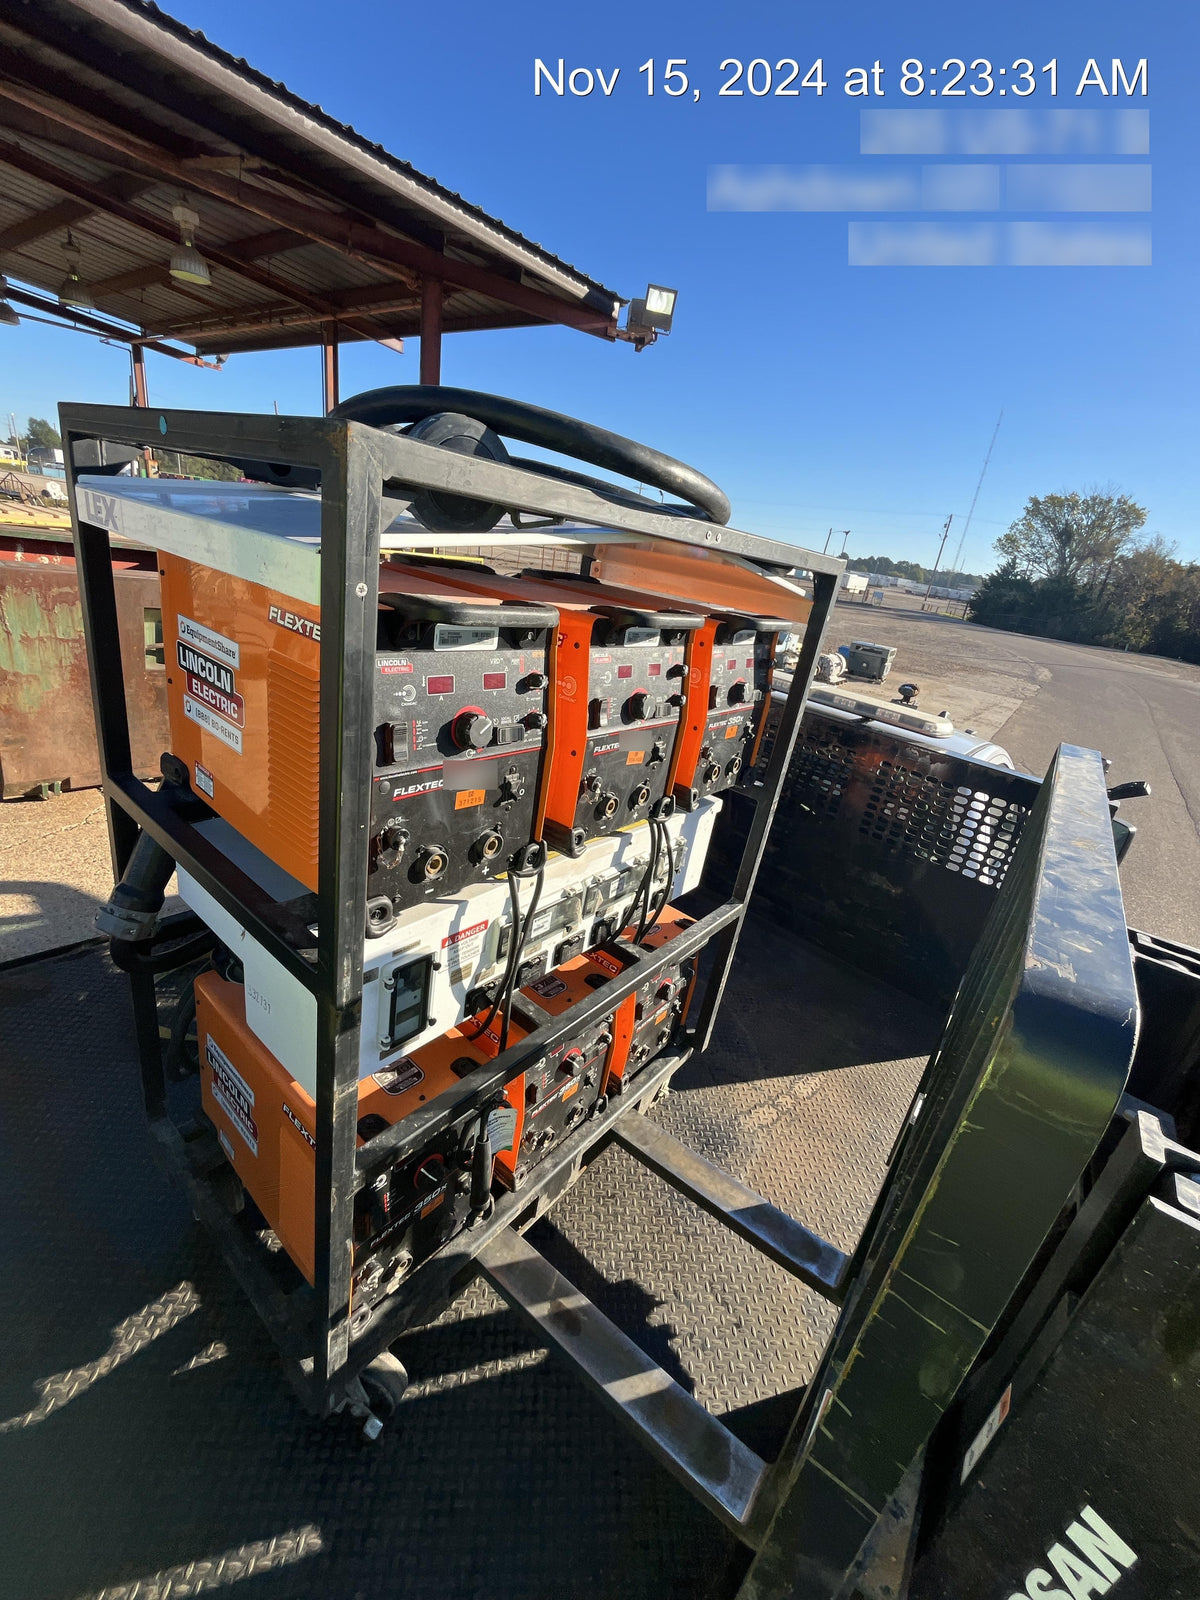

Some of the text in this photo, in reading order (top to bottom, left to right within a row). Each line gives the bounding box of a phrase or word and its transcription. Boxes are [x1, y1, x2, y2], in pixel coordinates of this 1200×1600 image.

[84, 491, 118, 530] LEX
[186, 625, 237, 659] EquipmentShare
[269, 606, 320, 641] FLEXTE
[179, 646, 232, 693] LINCOLN
[377, 659, 407, 667] LINCOLN
[192, 678, 238, 719] ELECTRIC
[211, 717, 239, 745] 80-RENTS
[394, 780, 443, 797] FLEXTEC
[454, 923, 486, 941] DANGER
[587, 952, 618, 973] XTEC
[208, 1051, 249, 1114] LINCOLN
[218, 1078, 254, 1133] ELECTRIC
[283, 1104, 315, 1148] FLEXT
[1008, 1504, 1139, 1600] SAN
